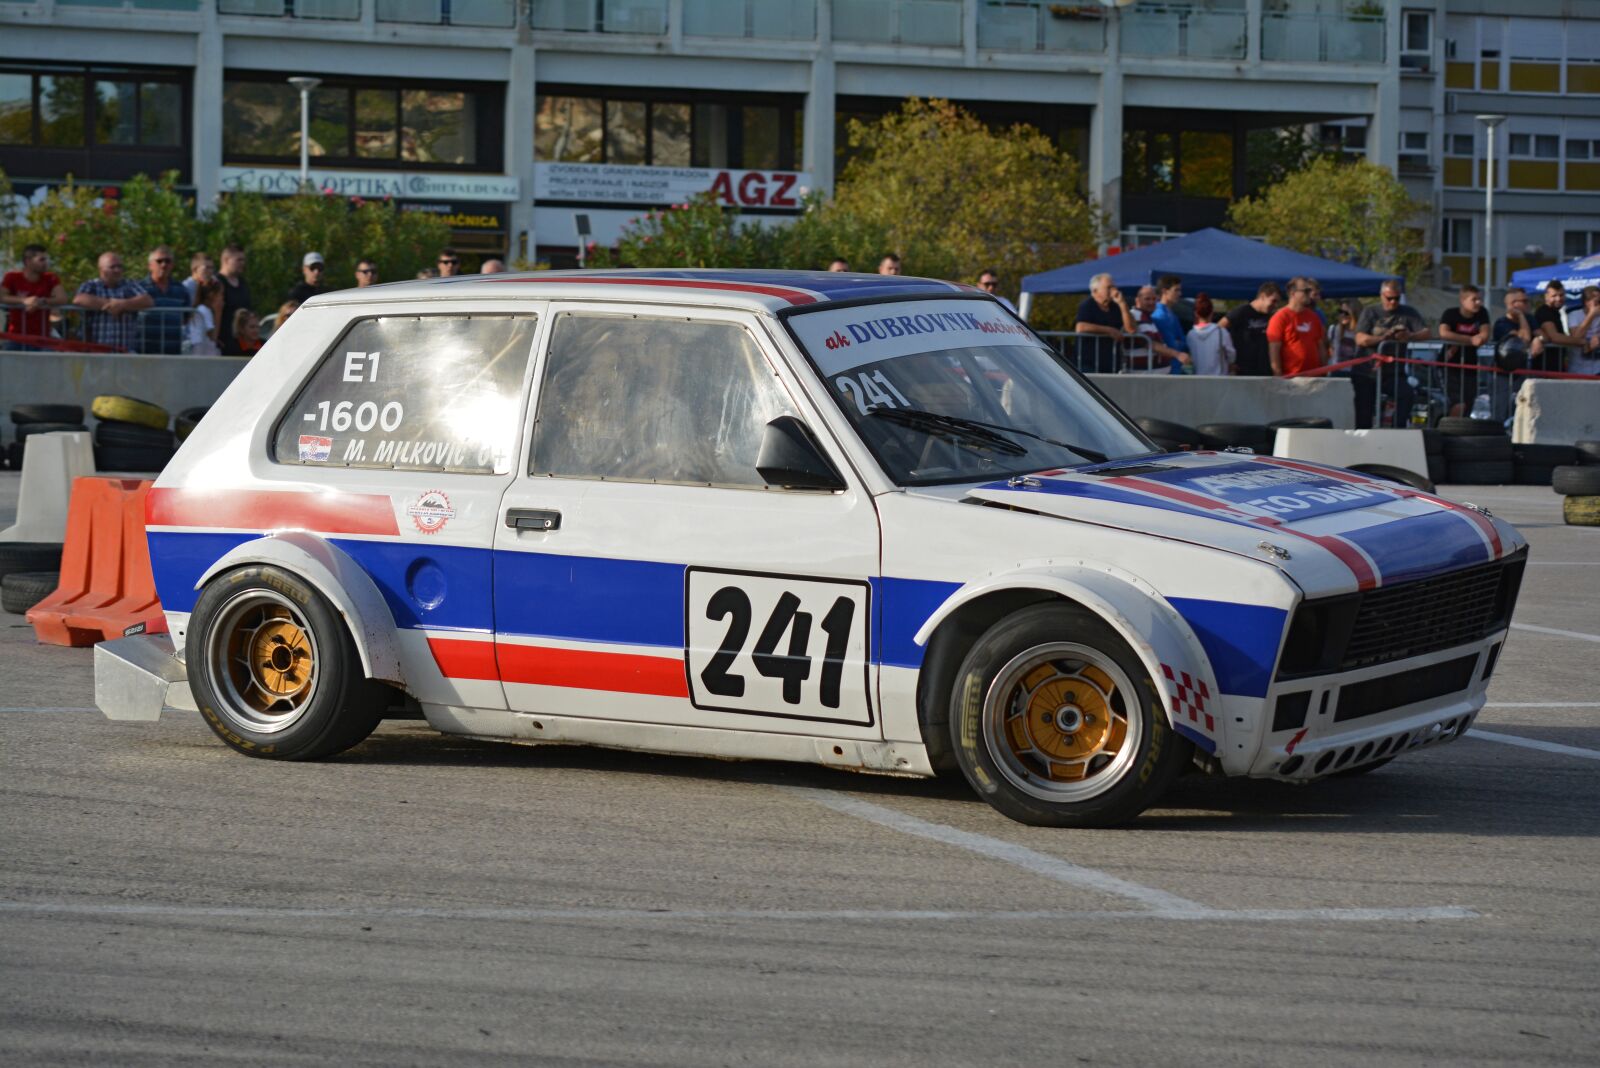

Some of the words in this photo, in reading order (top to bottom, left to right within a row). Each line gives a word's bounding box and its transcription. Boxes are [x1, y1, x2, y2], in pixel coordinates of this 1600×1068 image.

[323, 176, 402, 195] OPTIKA
[709, 171, 798, 207] AGZ
[825, 330, 850, 350] ak
[846, 312, 979, 344] DUBROVNIK
[343, 352, 380, 382] E1
[835, 369, 911, 416] 241
[303, 400, 404, 432] -1600
[343, 438, 366, 462] M.
[701, 586, 856, 709] 241
